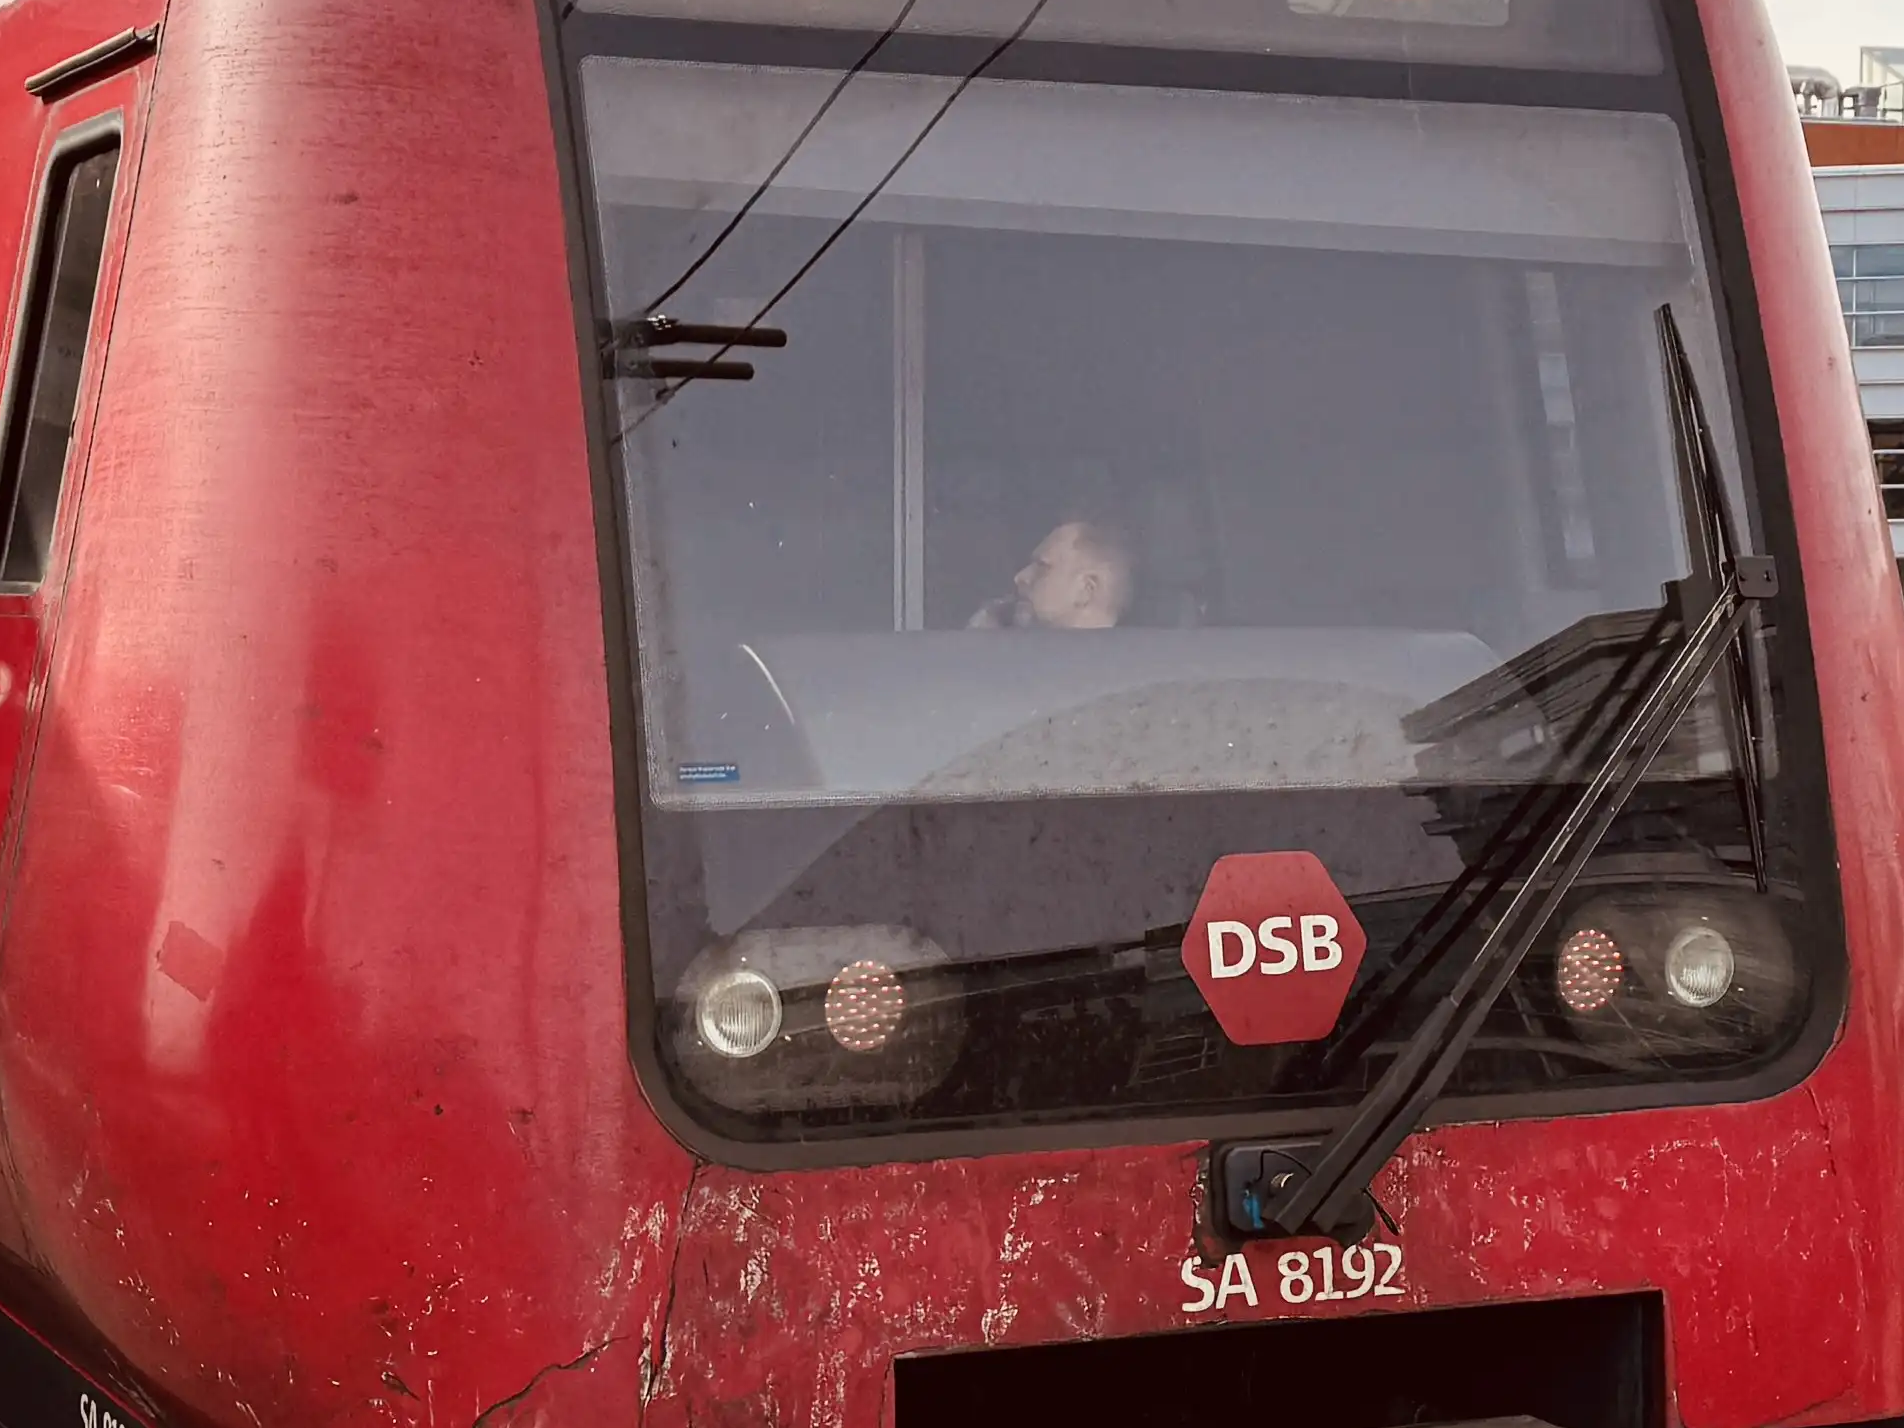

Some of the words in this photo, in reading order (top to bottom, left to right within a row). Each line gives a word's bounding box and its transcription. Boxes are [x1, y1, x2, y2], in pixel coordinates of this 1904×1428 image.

[1206, 914, 1344, 979] DSB
[1181, 1253, 1258, 1312] SA
[1278, 1243, 1406, 1304] 8192
